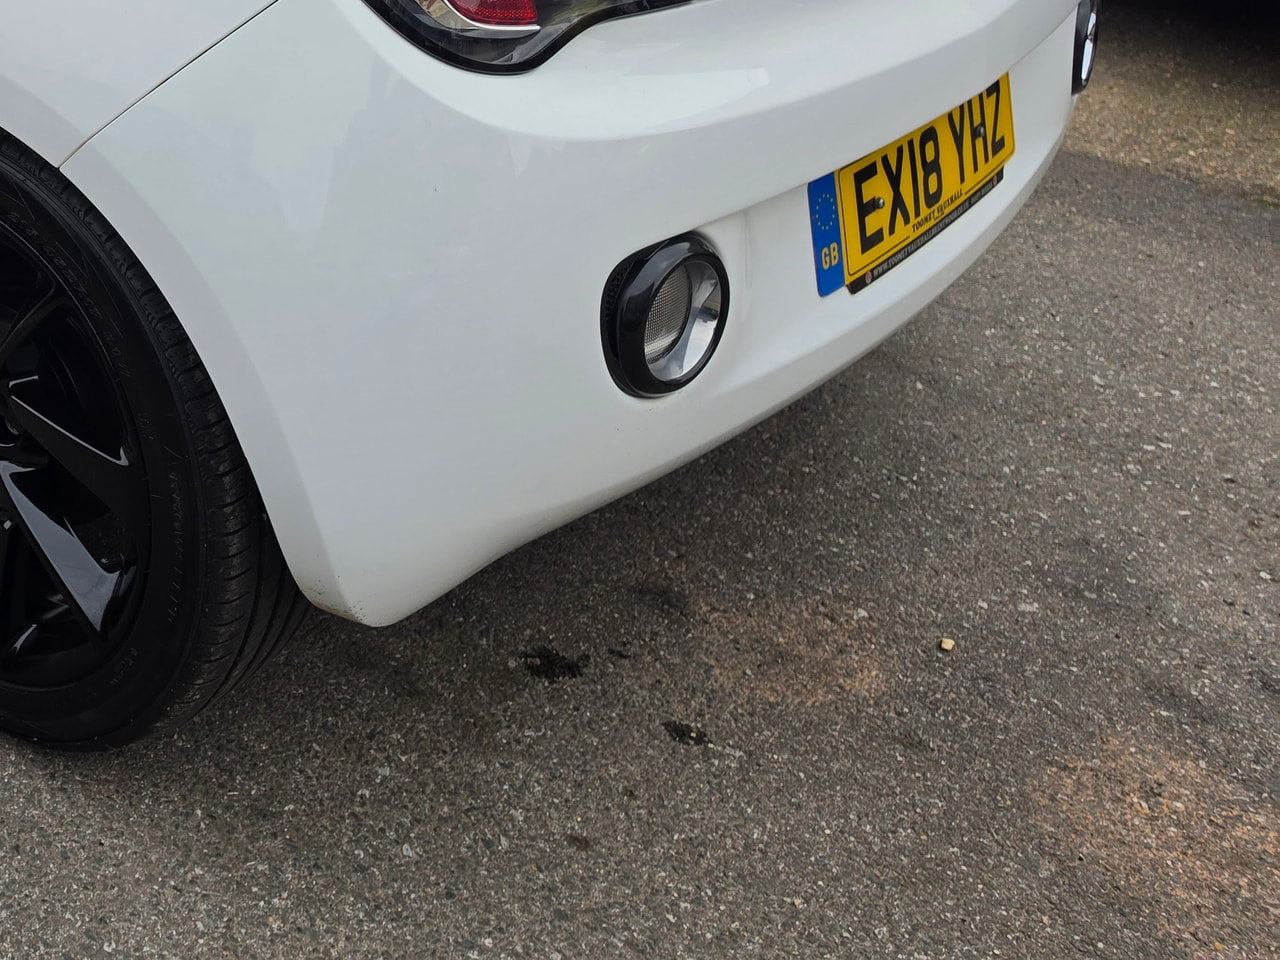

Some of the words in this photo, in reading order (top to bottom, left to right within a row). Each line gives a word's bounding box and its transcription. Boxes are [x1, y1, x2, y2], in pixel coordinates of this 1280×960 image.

[853, 125, 943, 255] EX18
[947, 79, 1006, 185] YHZ
[821, 242, 839, 270] GB
